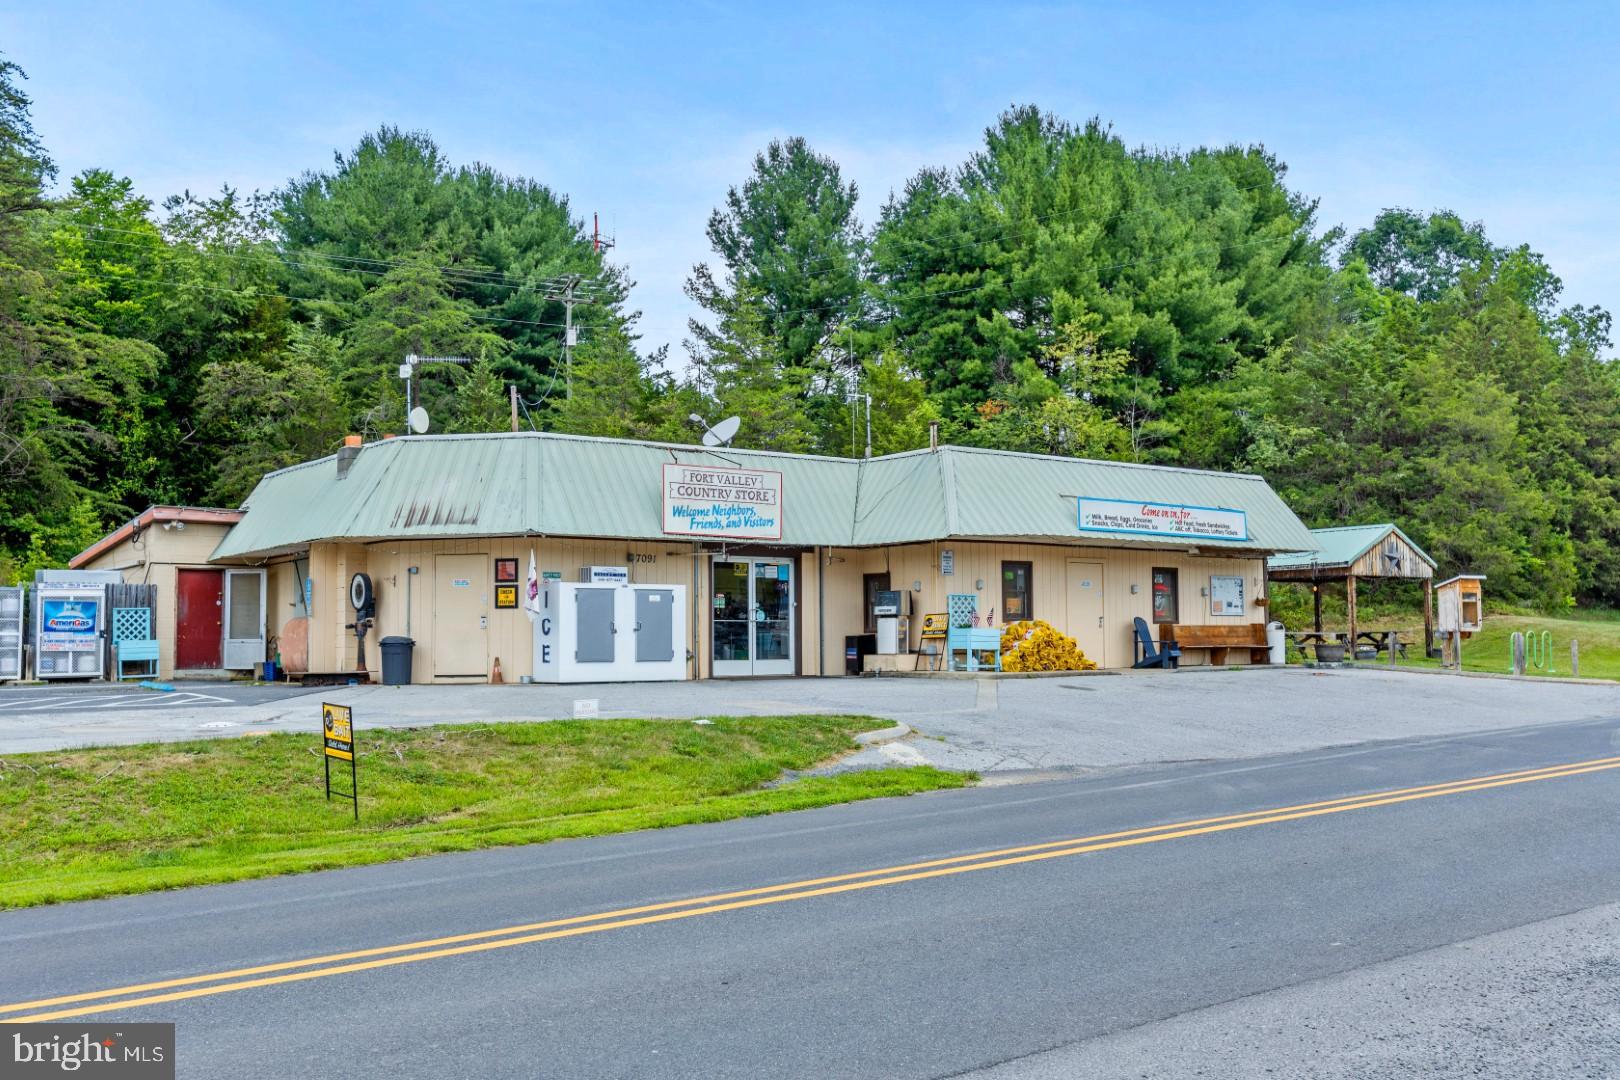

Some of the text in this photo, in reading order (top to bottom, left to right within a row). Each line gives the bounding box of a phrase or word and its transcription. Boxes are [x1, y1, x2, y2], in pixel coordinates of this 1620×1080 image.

[690, 472, 758, 487] FORT VALLEY
[677, 485, 770, 502] COUNTRY STORE
[672, 503, 756, 520] Welcome Neighbors,
[1141, 504, 1160, 517] Come
[1161, 510, 1169, 518] on
[689, 515, 775, 530] Friends, and Visitors
[636, 553, 656, 563] 7091
[49, 619, 90, 627] AmeriGas
[541, 590, 551, 664] ICE
[333, 708, 350, 724] LIVE
[333, 724, 351, 738] BAIT
